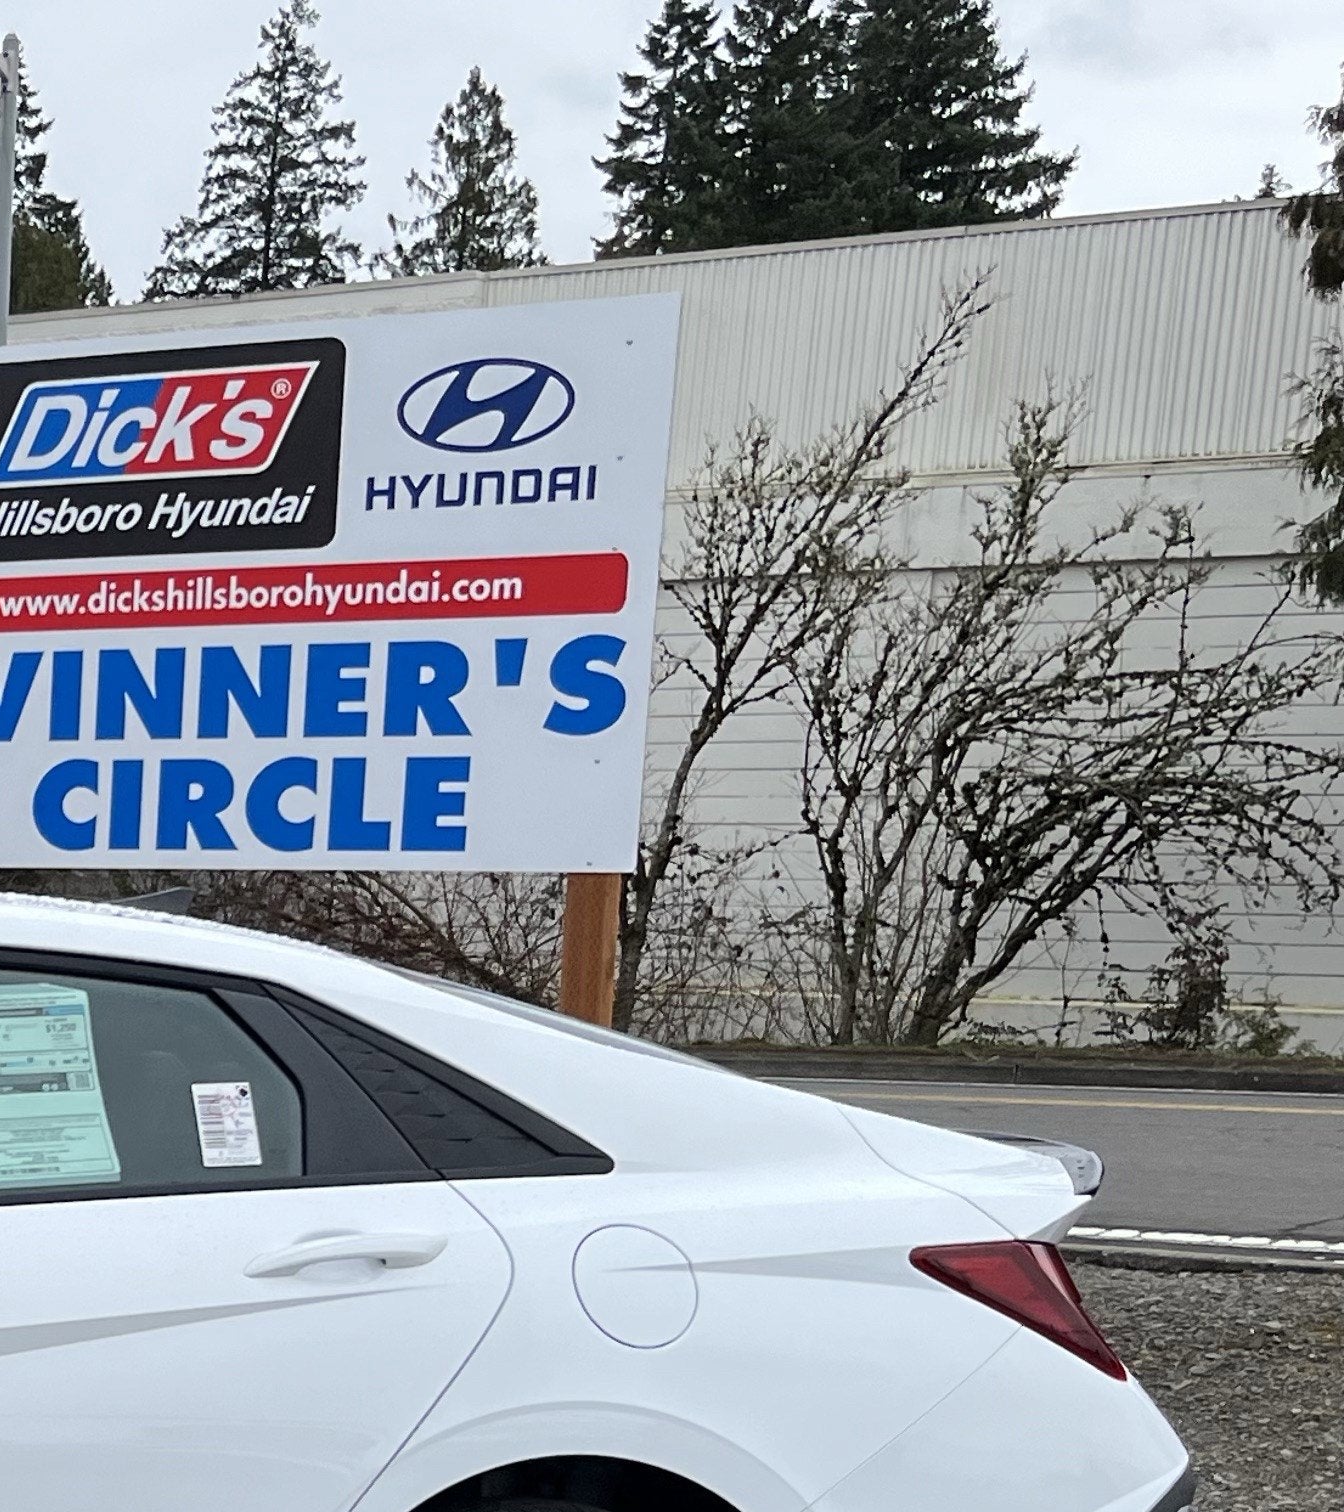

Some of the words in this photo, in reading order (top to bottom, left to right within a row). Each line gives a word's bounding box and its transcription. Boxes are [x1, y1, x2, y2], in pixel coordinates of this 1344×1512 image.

[7, 379, 274, 473] Dick's
[147, 485, 316, 538] Hyundai
[365, 464, 598, 511] HYUNDAI
[31, 755, 472, 853] CIRCLE
